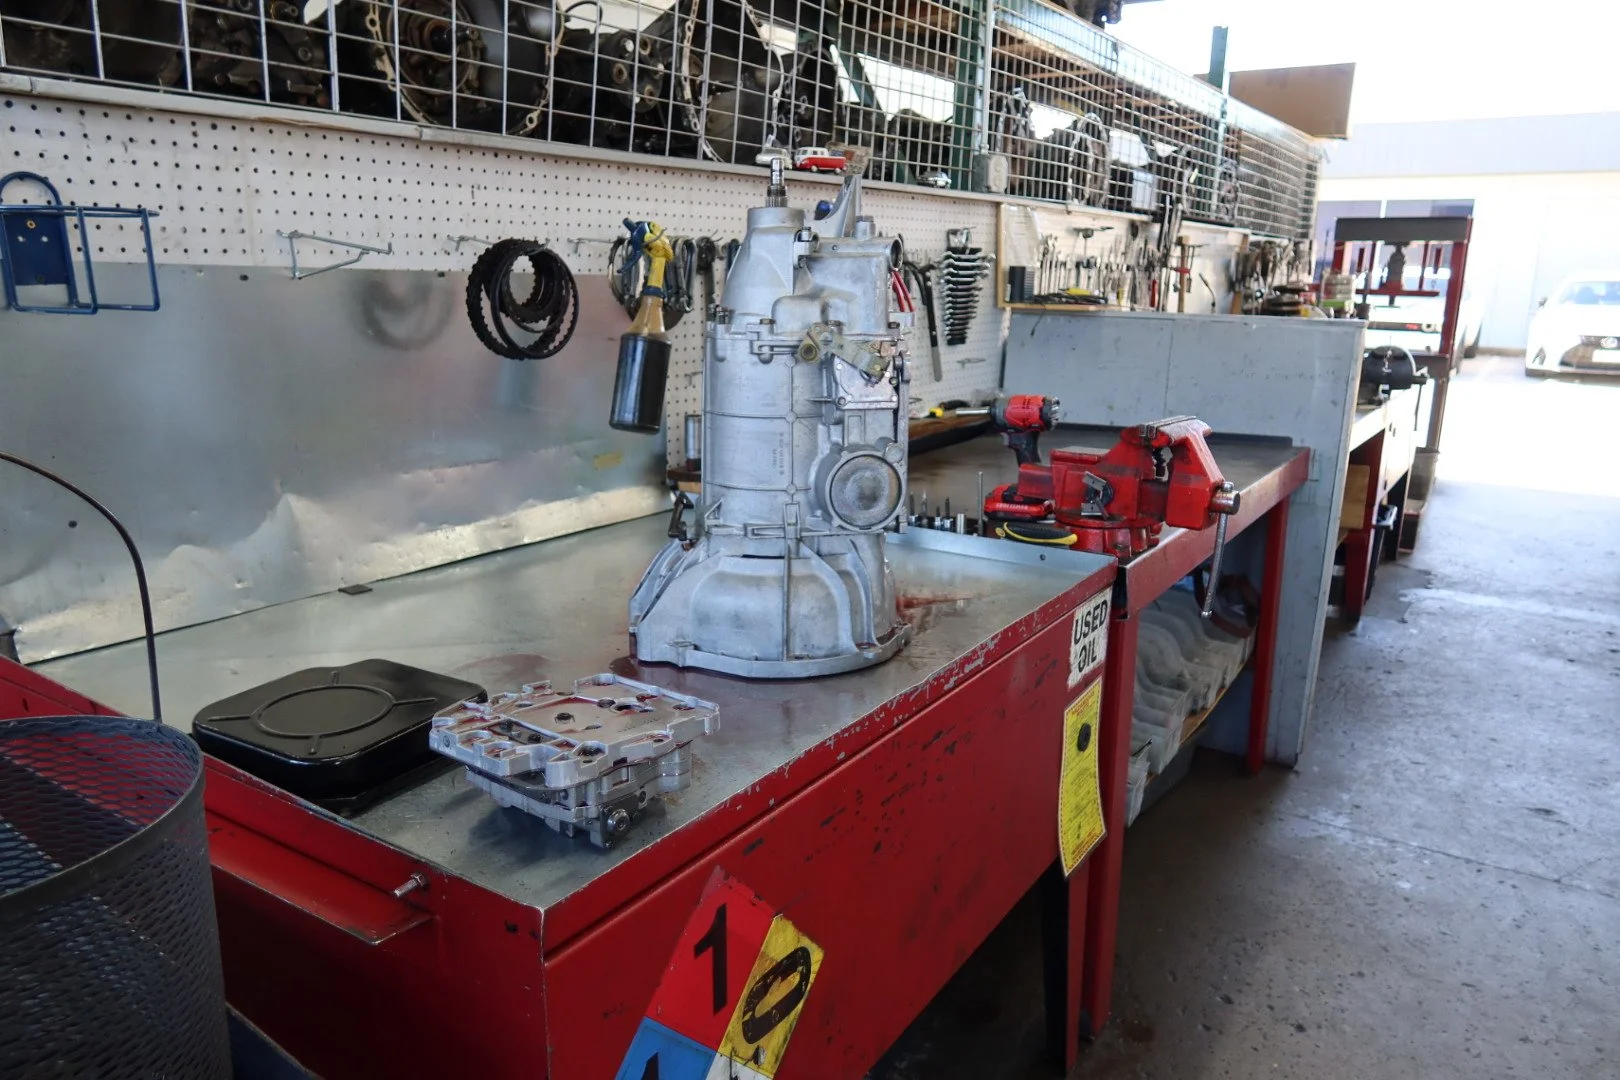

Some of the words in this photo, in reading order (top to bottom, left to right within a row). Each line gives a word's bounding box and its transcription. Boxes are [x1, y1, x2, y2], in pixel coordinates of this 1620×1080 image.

[1074, 600, 1107, 645] USED
[1078, 637, 1097, 673] OIL
[694, 903, 728, 1015] 1
[742, 946, 812, 1044] 0
